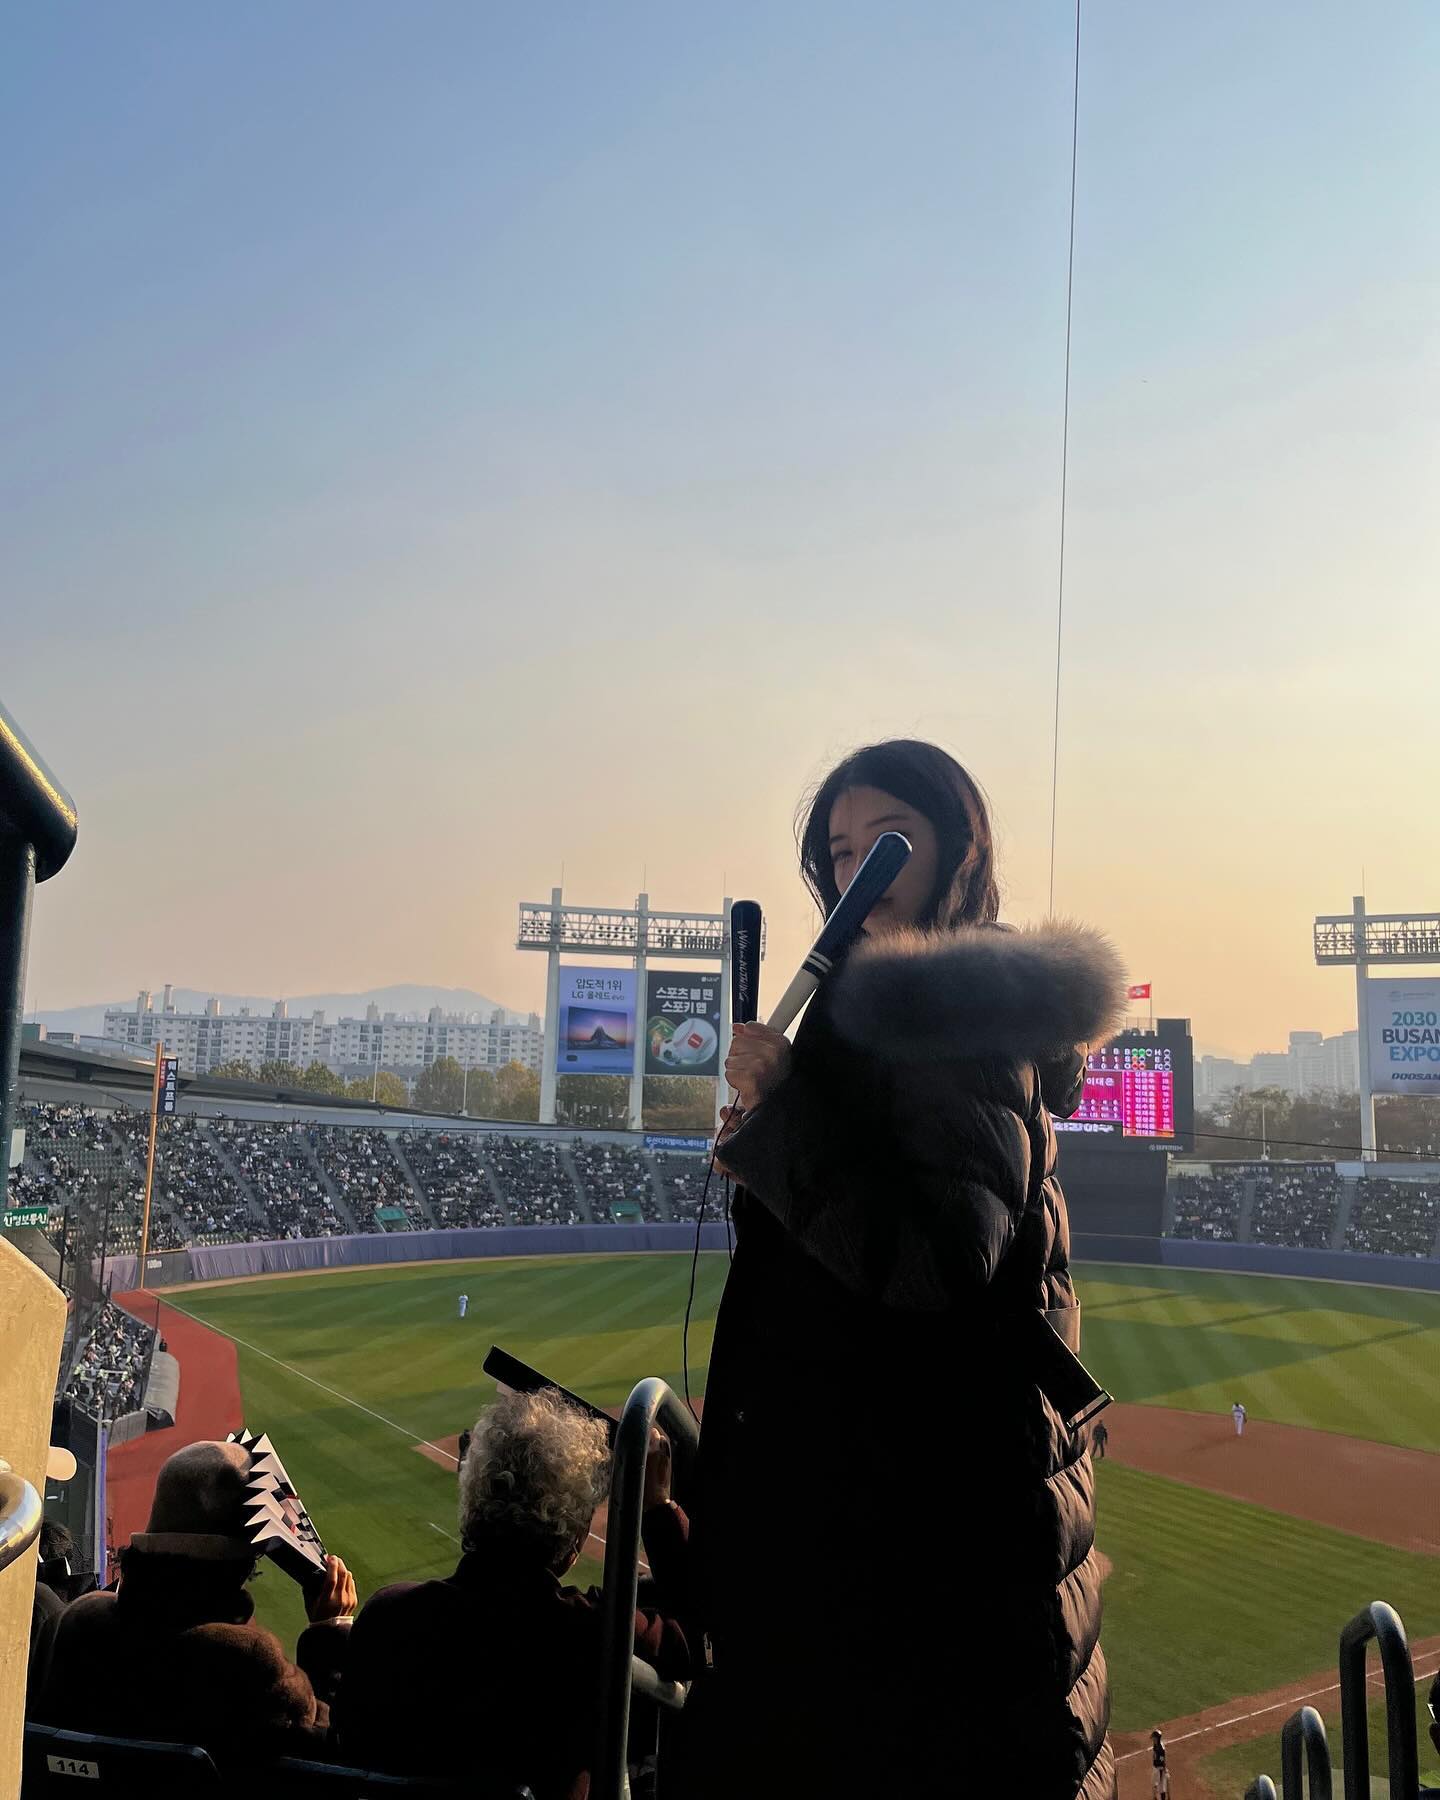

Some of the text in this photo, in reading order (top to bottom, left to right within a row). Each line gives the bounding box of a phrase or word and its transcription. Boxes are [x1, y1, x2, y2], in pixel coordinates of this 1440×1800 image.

[576, 978, 622, 991] 압도적 1위
[572, 991, 584, 999] LG
[587, 991, 610, 1000] 올레드
[656, 987, 688, 999] 스포츠
[662, 1001, 706, 1014] 스포키 앱
[1392, 1012, 1437, 1026] 2030
[1390, 1046, 1440, 1061] EXPO
[56, 1760, 89, 1775] 114
